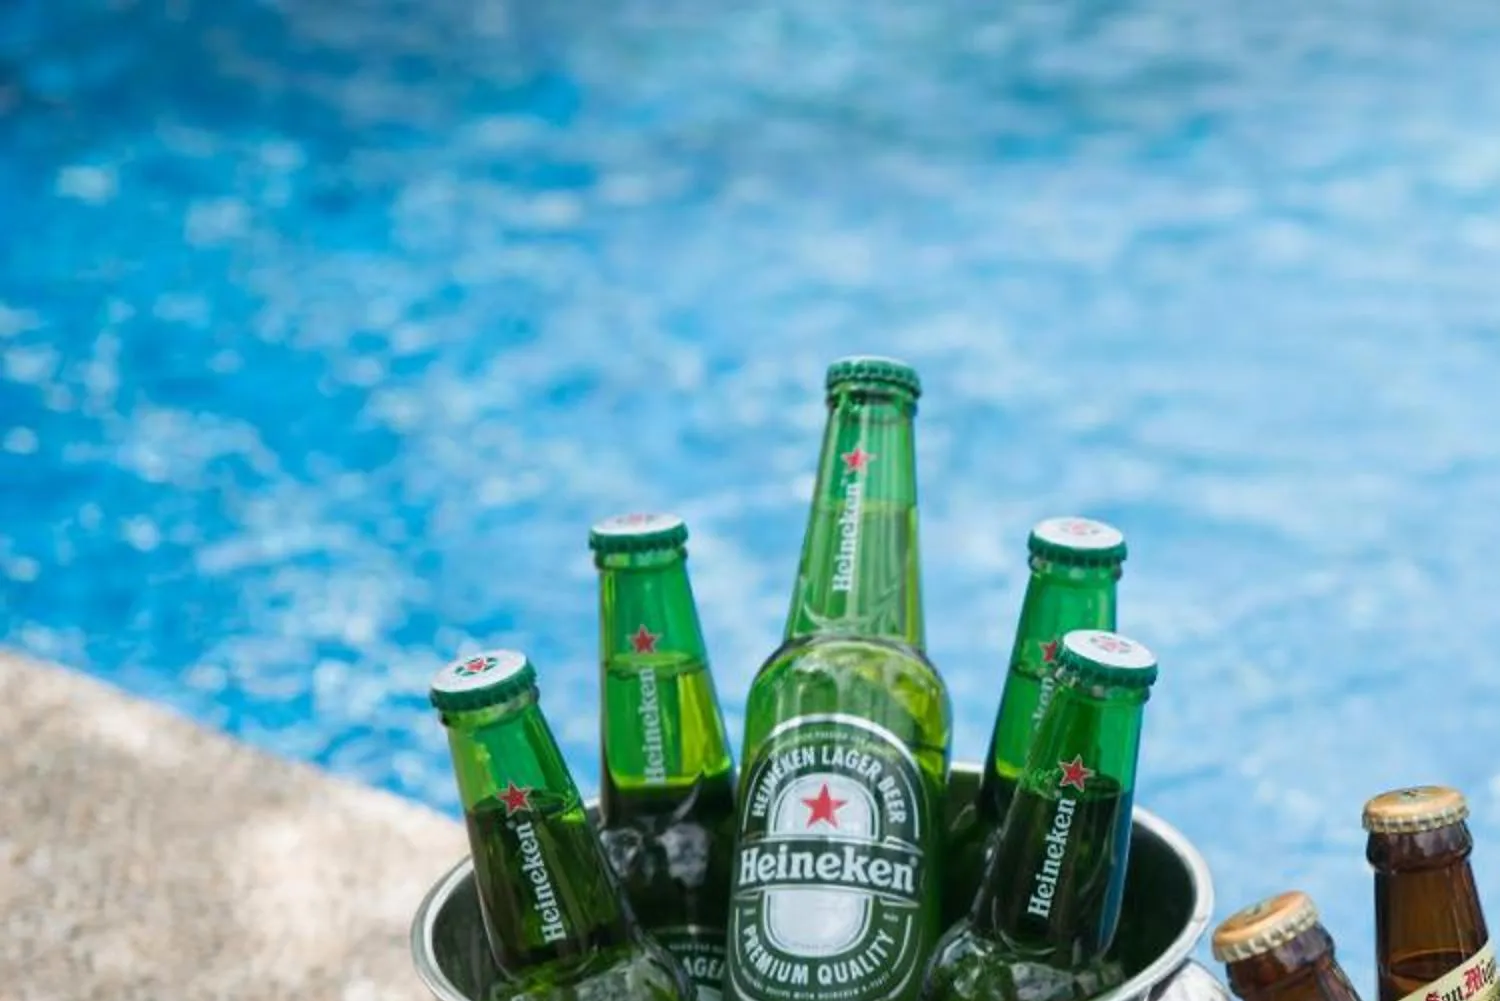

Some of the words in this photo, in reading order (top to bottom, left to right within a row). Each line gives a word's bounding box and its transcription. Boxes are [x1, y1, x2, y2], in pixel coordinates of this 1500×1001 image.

[832, 481, 861, 592] Heineken
[752, 746, 816, 817] HEINEKEN
[821, 745, 882, 782] LAGER
[877, 775, 907, 825] BEER
[516, 820, 567, 944] Heineken
[738, 843, 915, 894] Heineken
[1027, 799, 1077, 919] Heineken
[743, 924, 809, 986] PREMIUM
[817, 928, 895, 986] QUALITY
